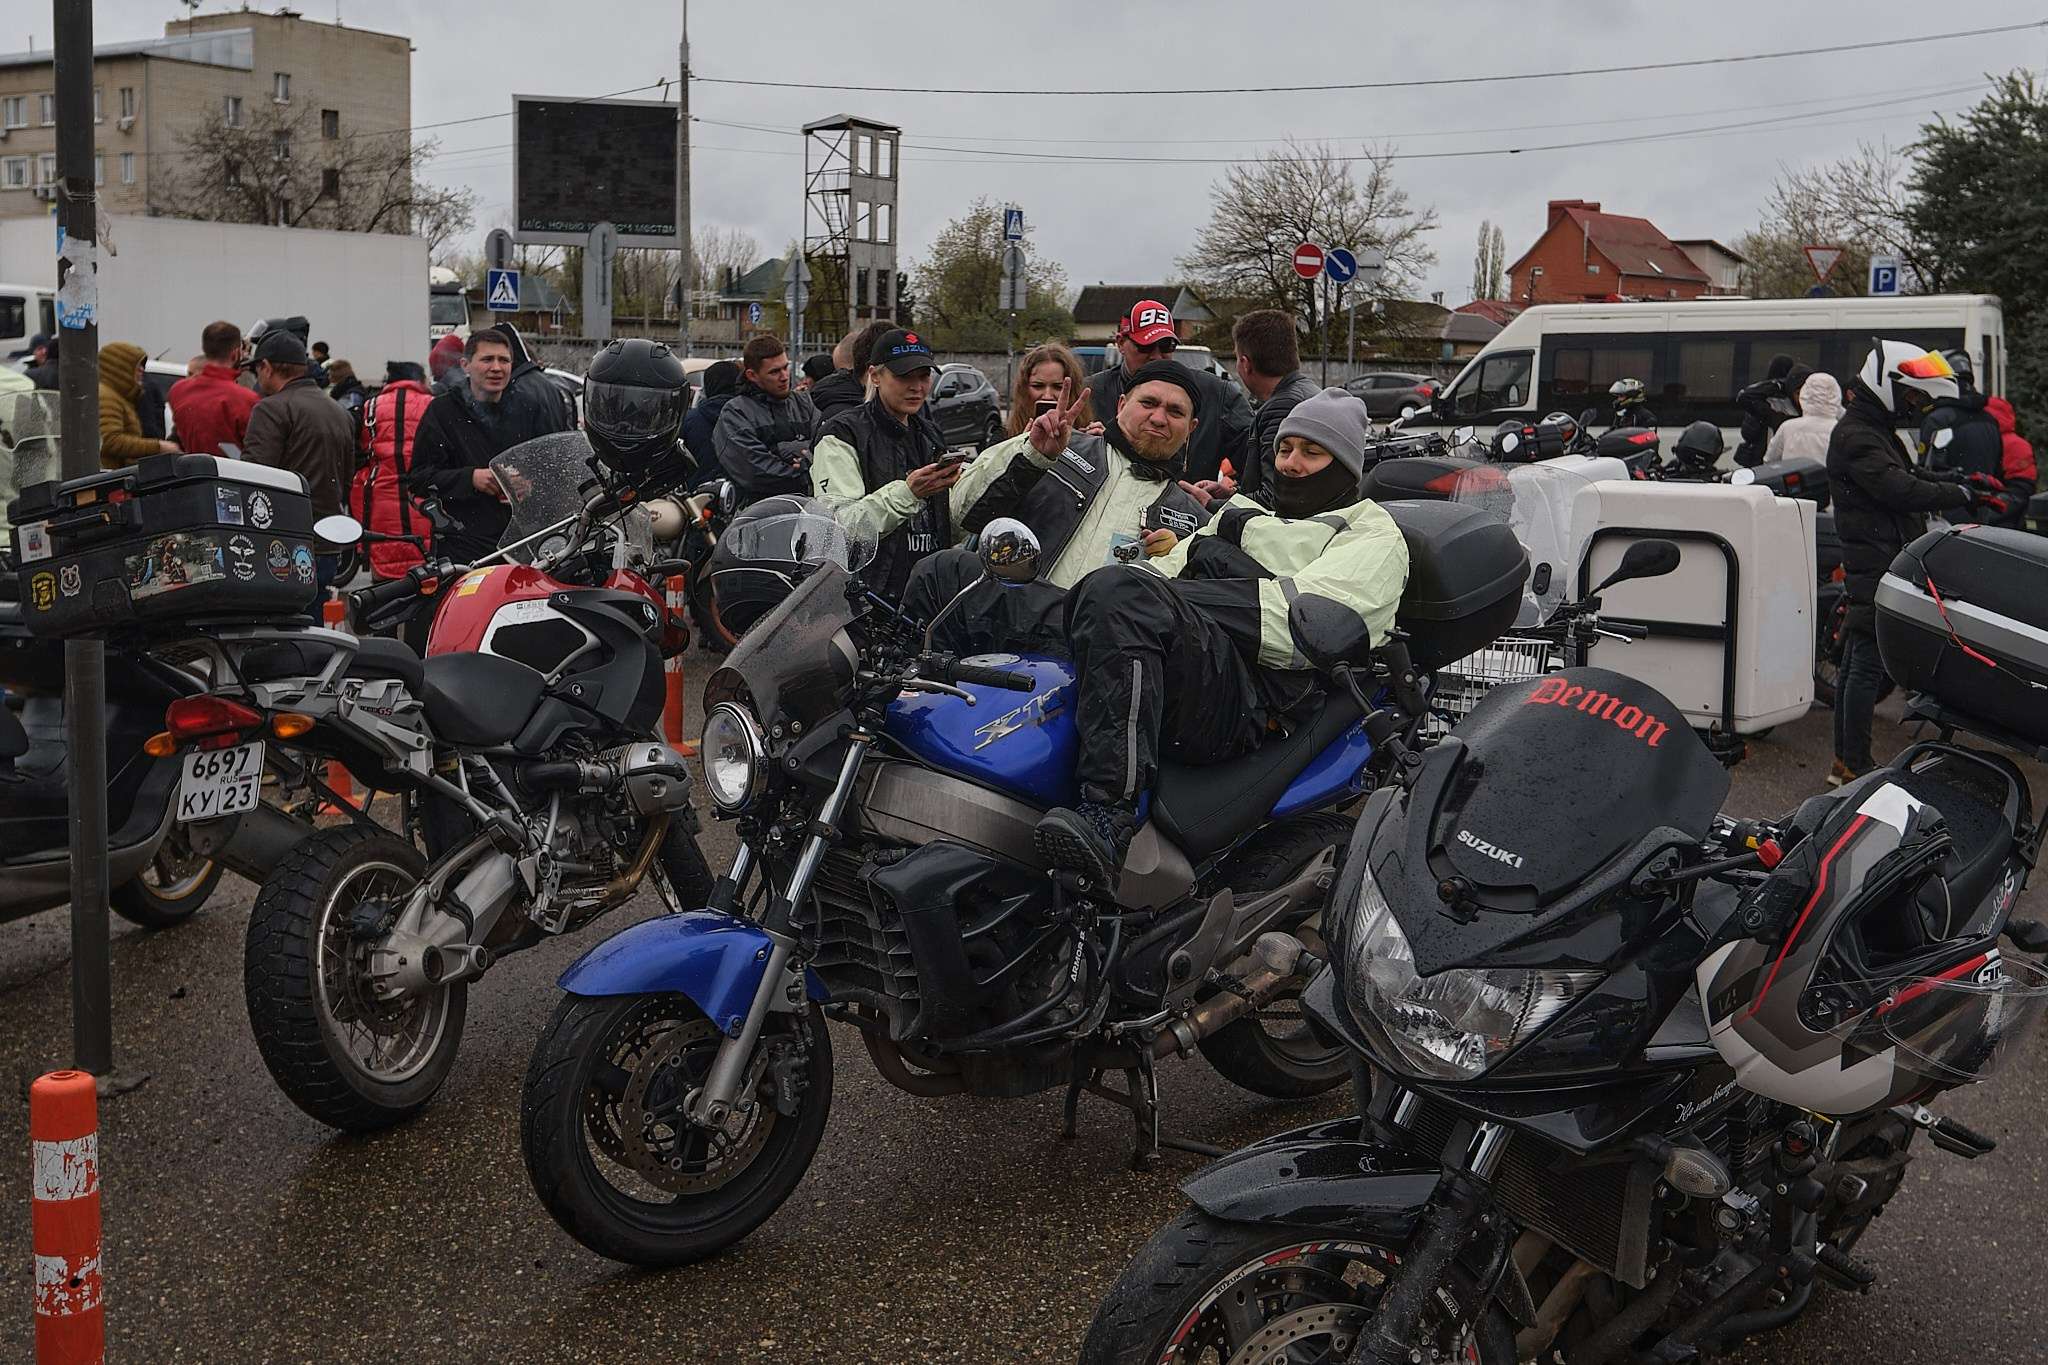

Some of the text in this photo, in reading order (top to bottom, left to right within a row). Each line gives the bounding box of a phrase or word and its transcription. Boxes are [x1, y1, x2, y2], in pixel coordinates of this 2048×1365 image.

[1879, 269, 1893, 290] P
[1139, 309, 1169, 328] 93
[1521, 677, 1671, 747] Demon
[192, 746, 251, 779] 6697
[220, 775, 239, 785] RUS
[222, 783, 252, 811] 23
[1457, 830, 1524, 869] SUZUKI
[1070, 941, 1084, 983] ARMOR
[1215, 1270, 1245, 1295] SUZUKI
[1443, 1295, 1459, 1315] SUZU
